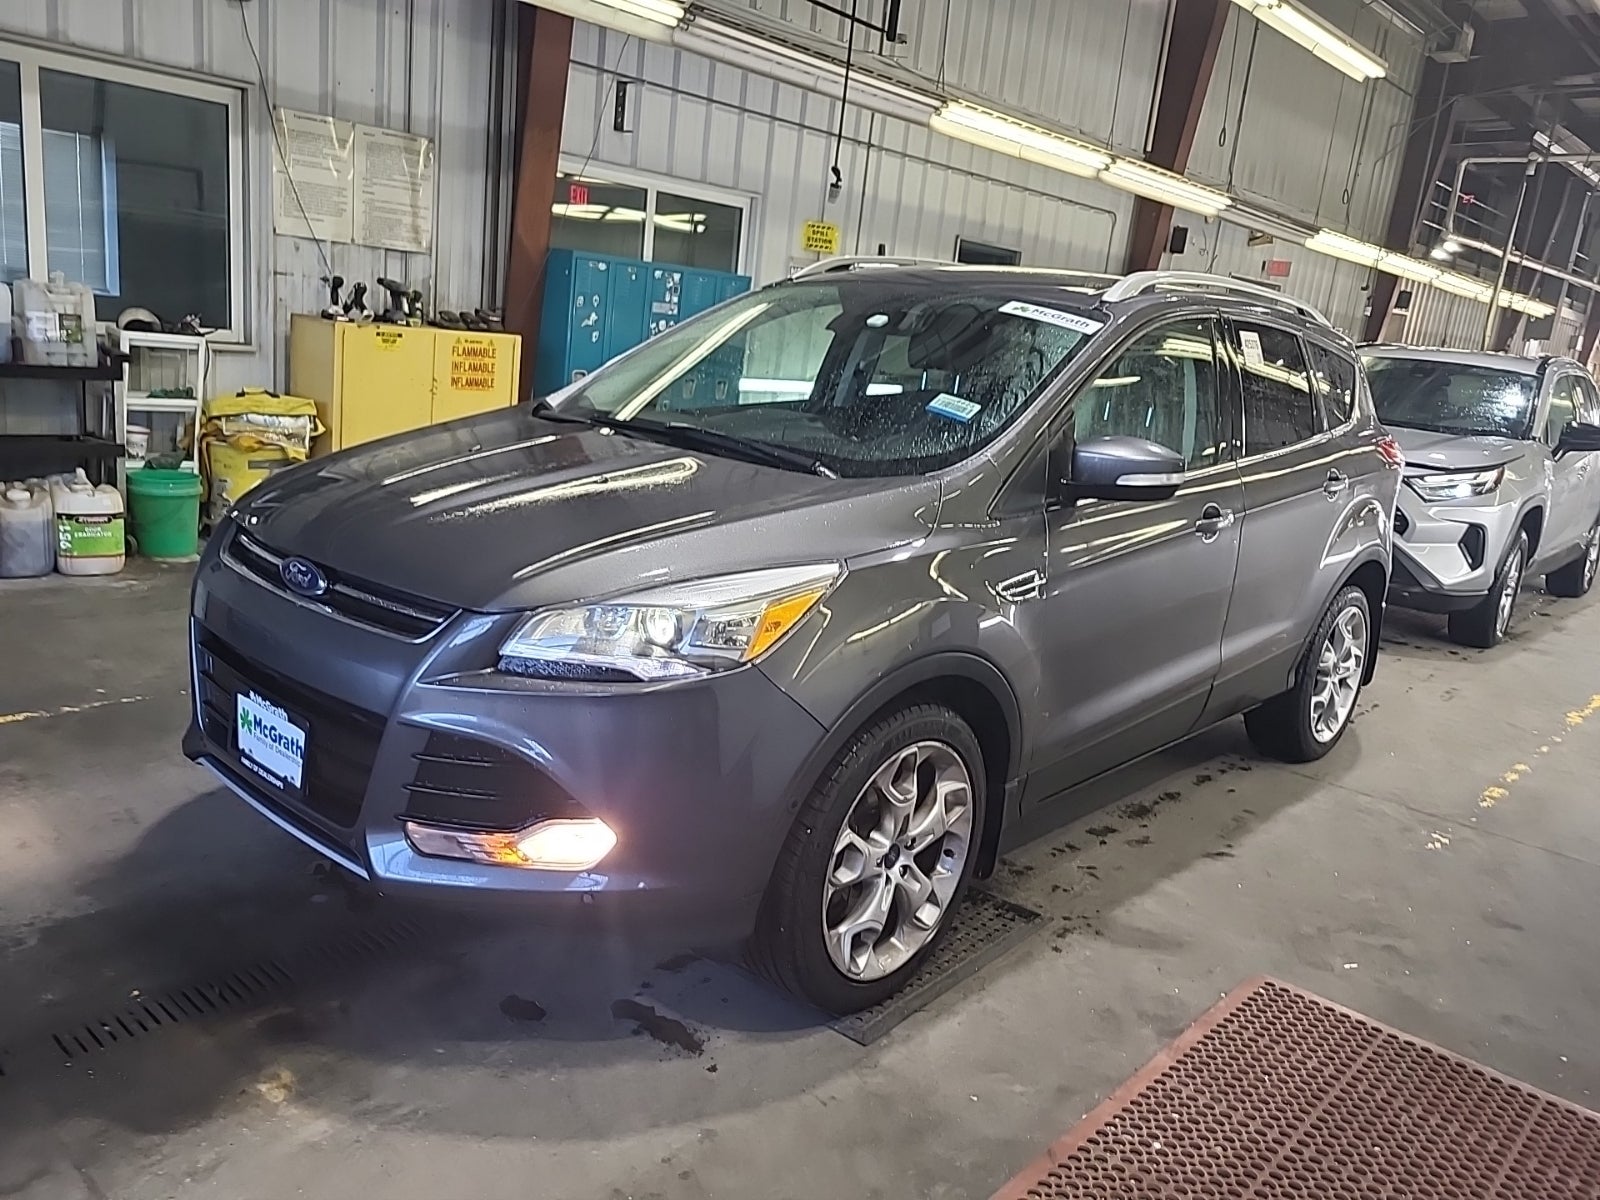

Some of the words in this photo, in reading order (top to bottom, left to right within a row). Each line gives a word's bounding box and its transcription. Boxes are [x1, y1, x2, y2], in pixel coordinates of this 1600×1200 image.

[570, 185, 589, 205] EXIT
[811, 229, 829, 237] SPILL
[807, 236, 833, 245] STATION
[1031, 308, 1090, 328] McGrath
[452, 345, 497, 359] FLAMMABLE
[451, 360, 496, 374] INFLAMABLE
[450, 375, 495, 389] INFLAMMABLE
[285, 561, 312, 588] Ford
[253, 713, 304, 761] McGrath
